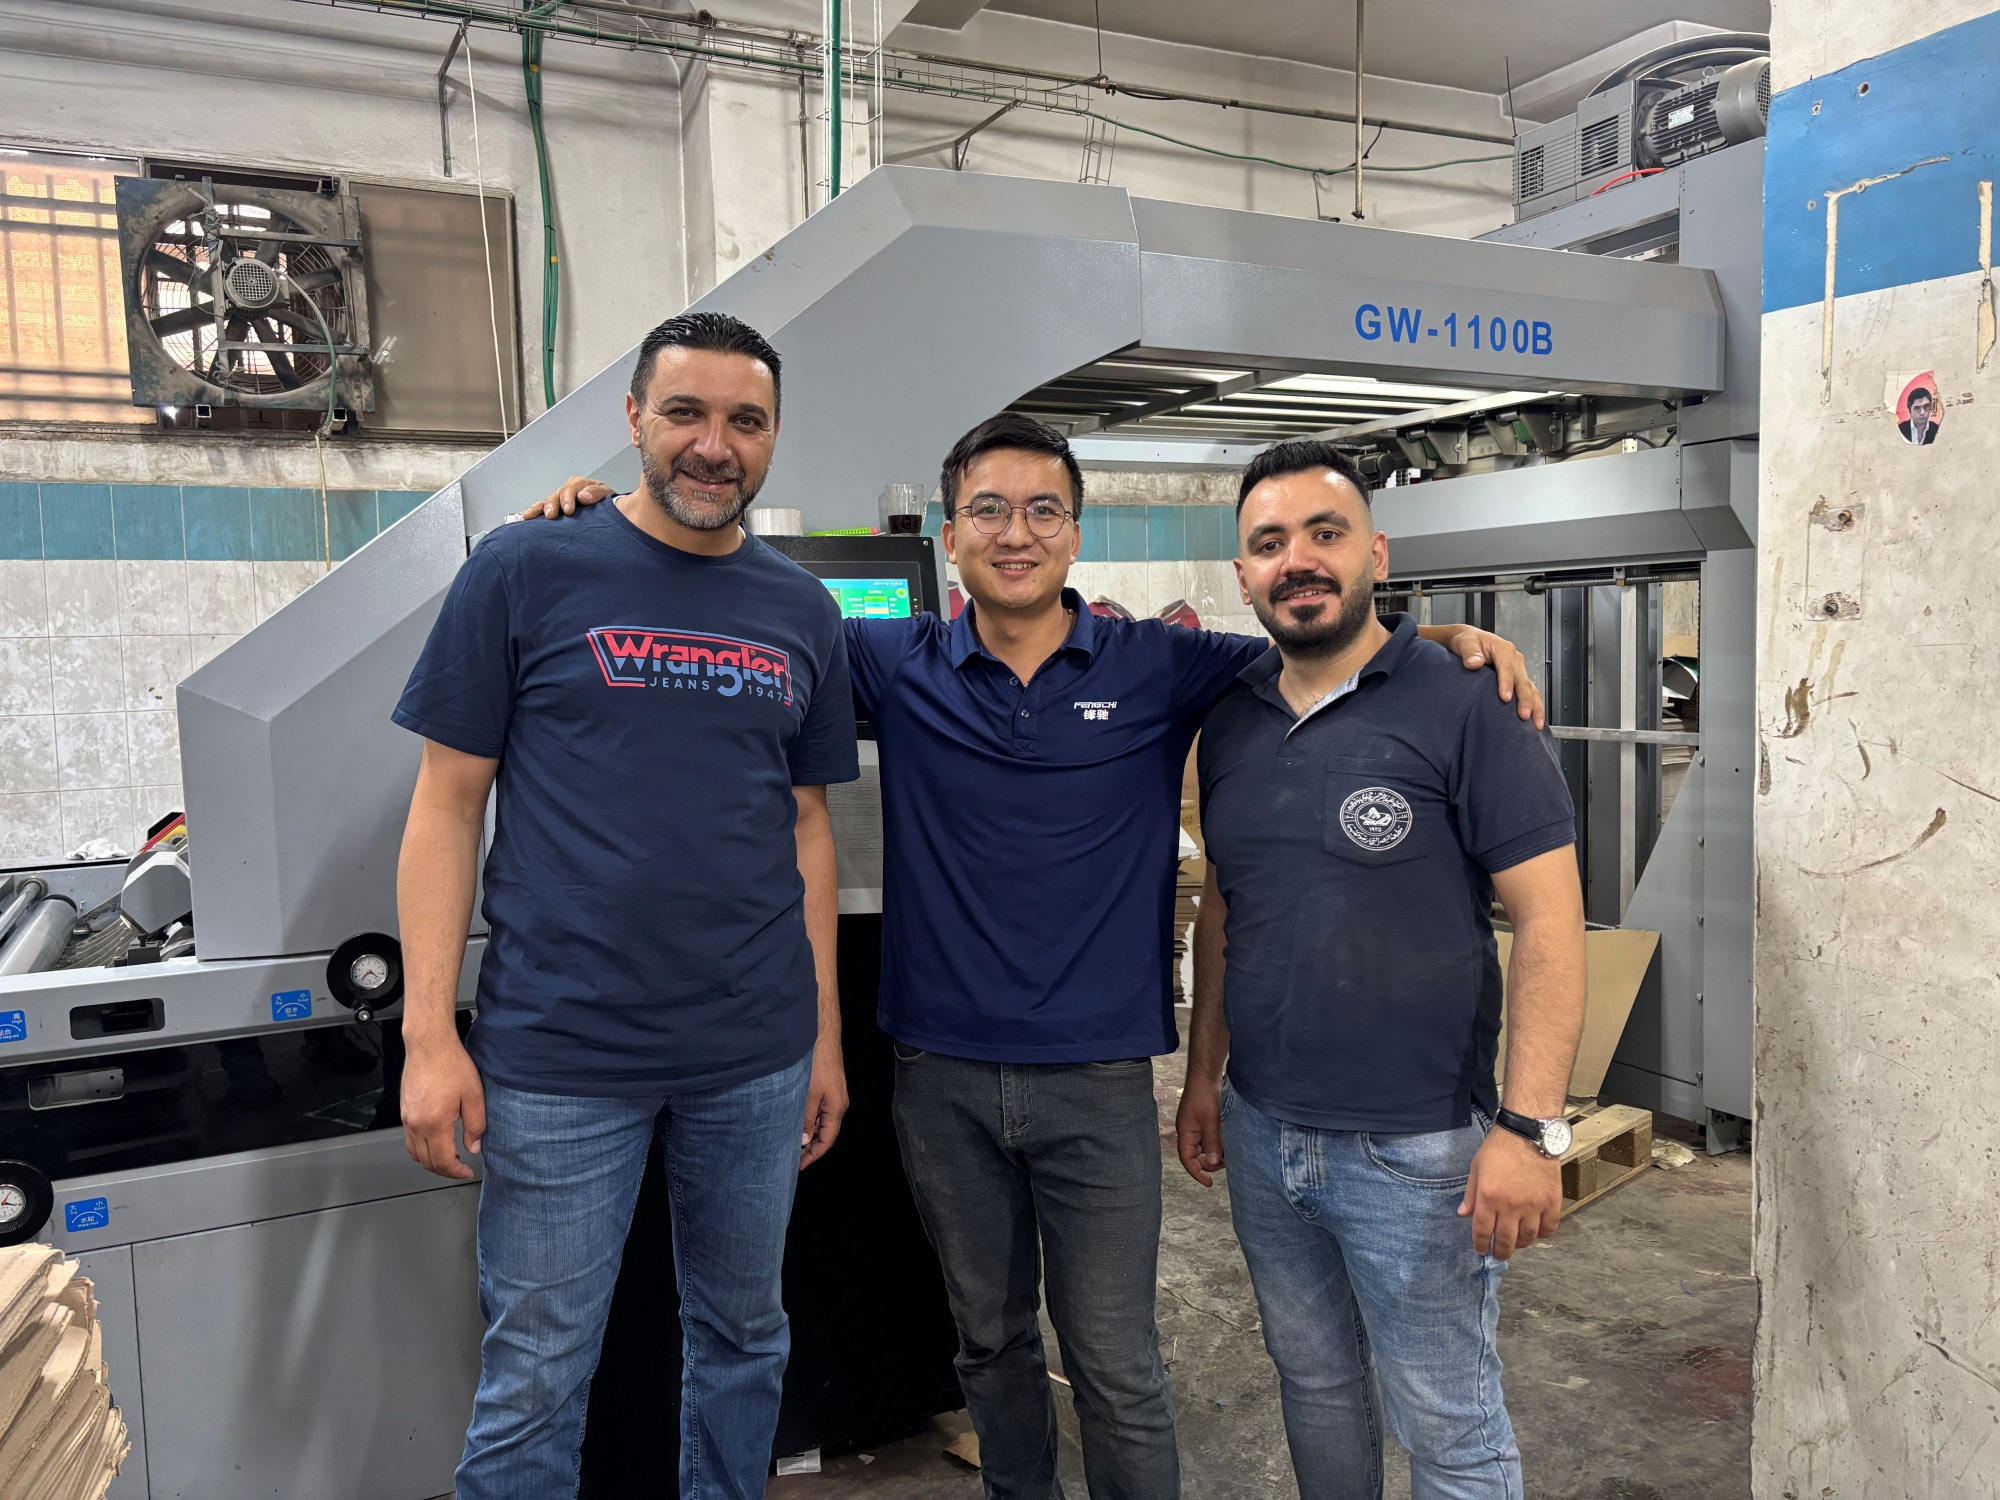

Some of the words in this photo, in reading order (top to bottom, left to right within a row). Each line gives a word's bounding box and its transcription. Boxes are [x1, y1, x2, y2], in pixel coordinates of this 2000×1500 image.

[1355, 303, 1553, 356] GW-1100B
[604, 634, 785, 697] Wrangler
[649, 677, 711, 691] JEANS
[747, 684, 783, 702] 1947
